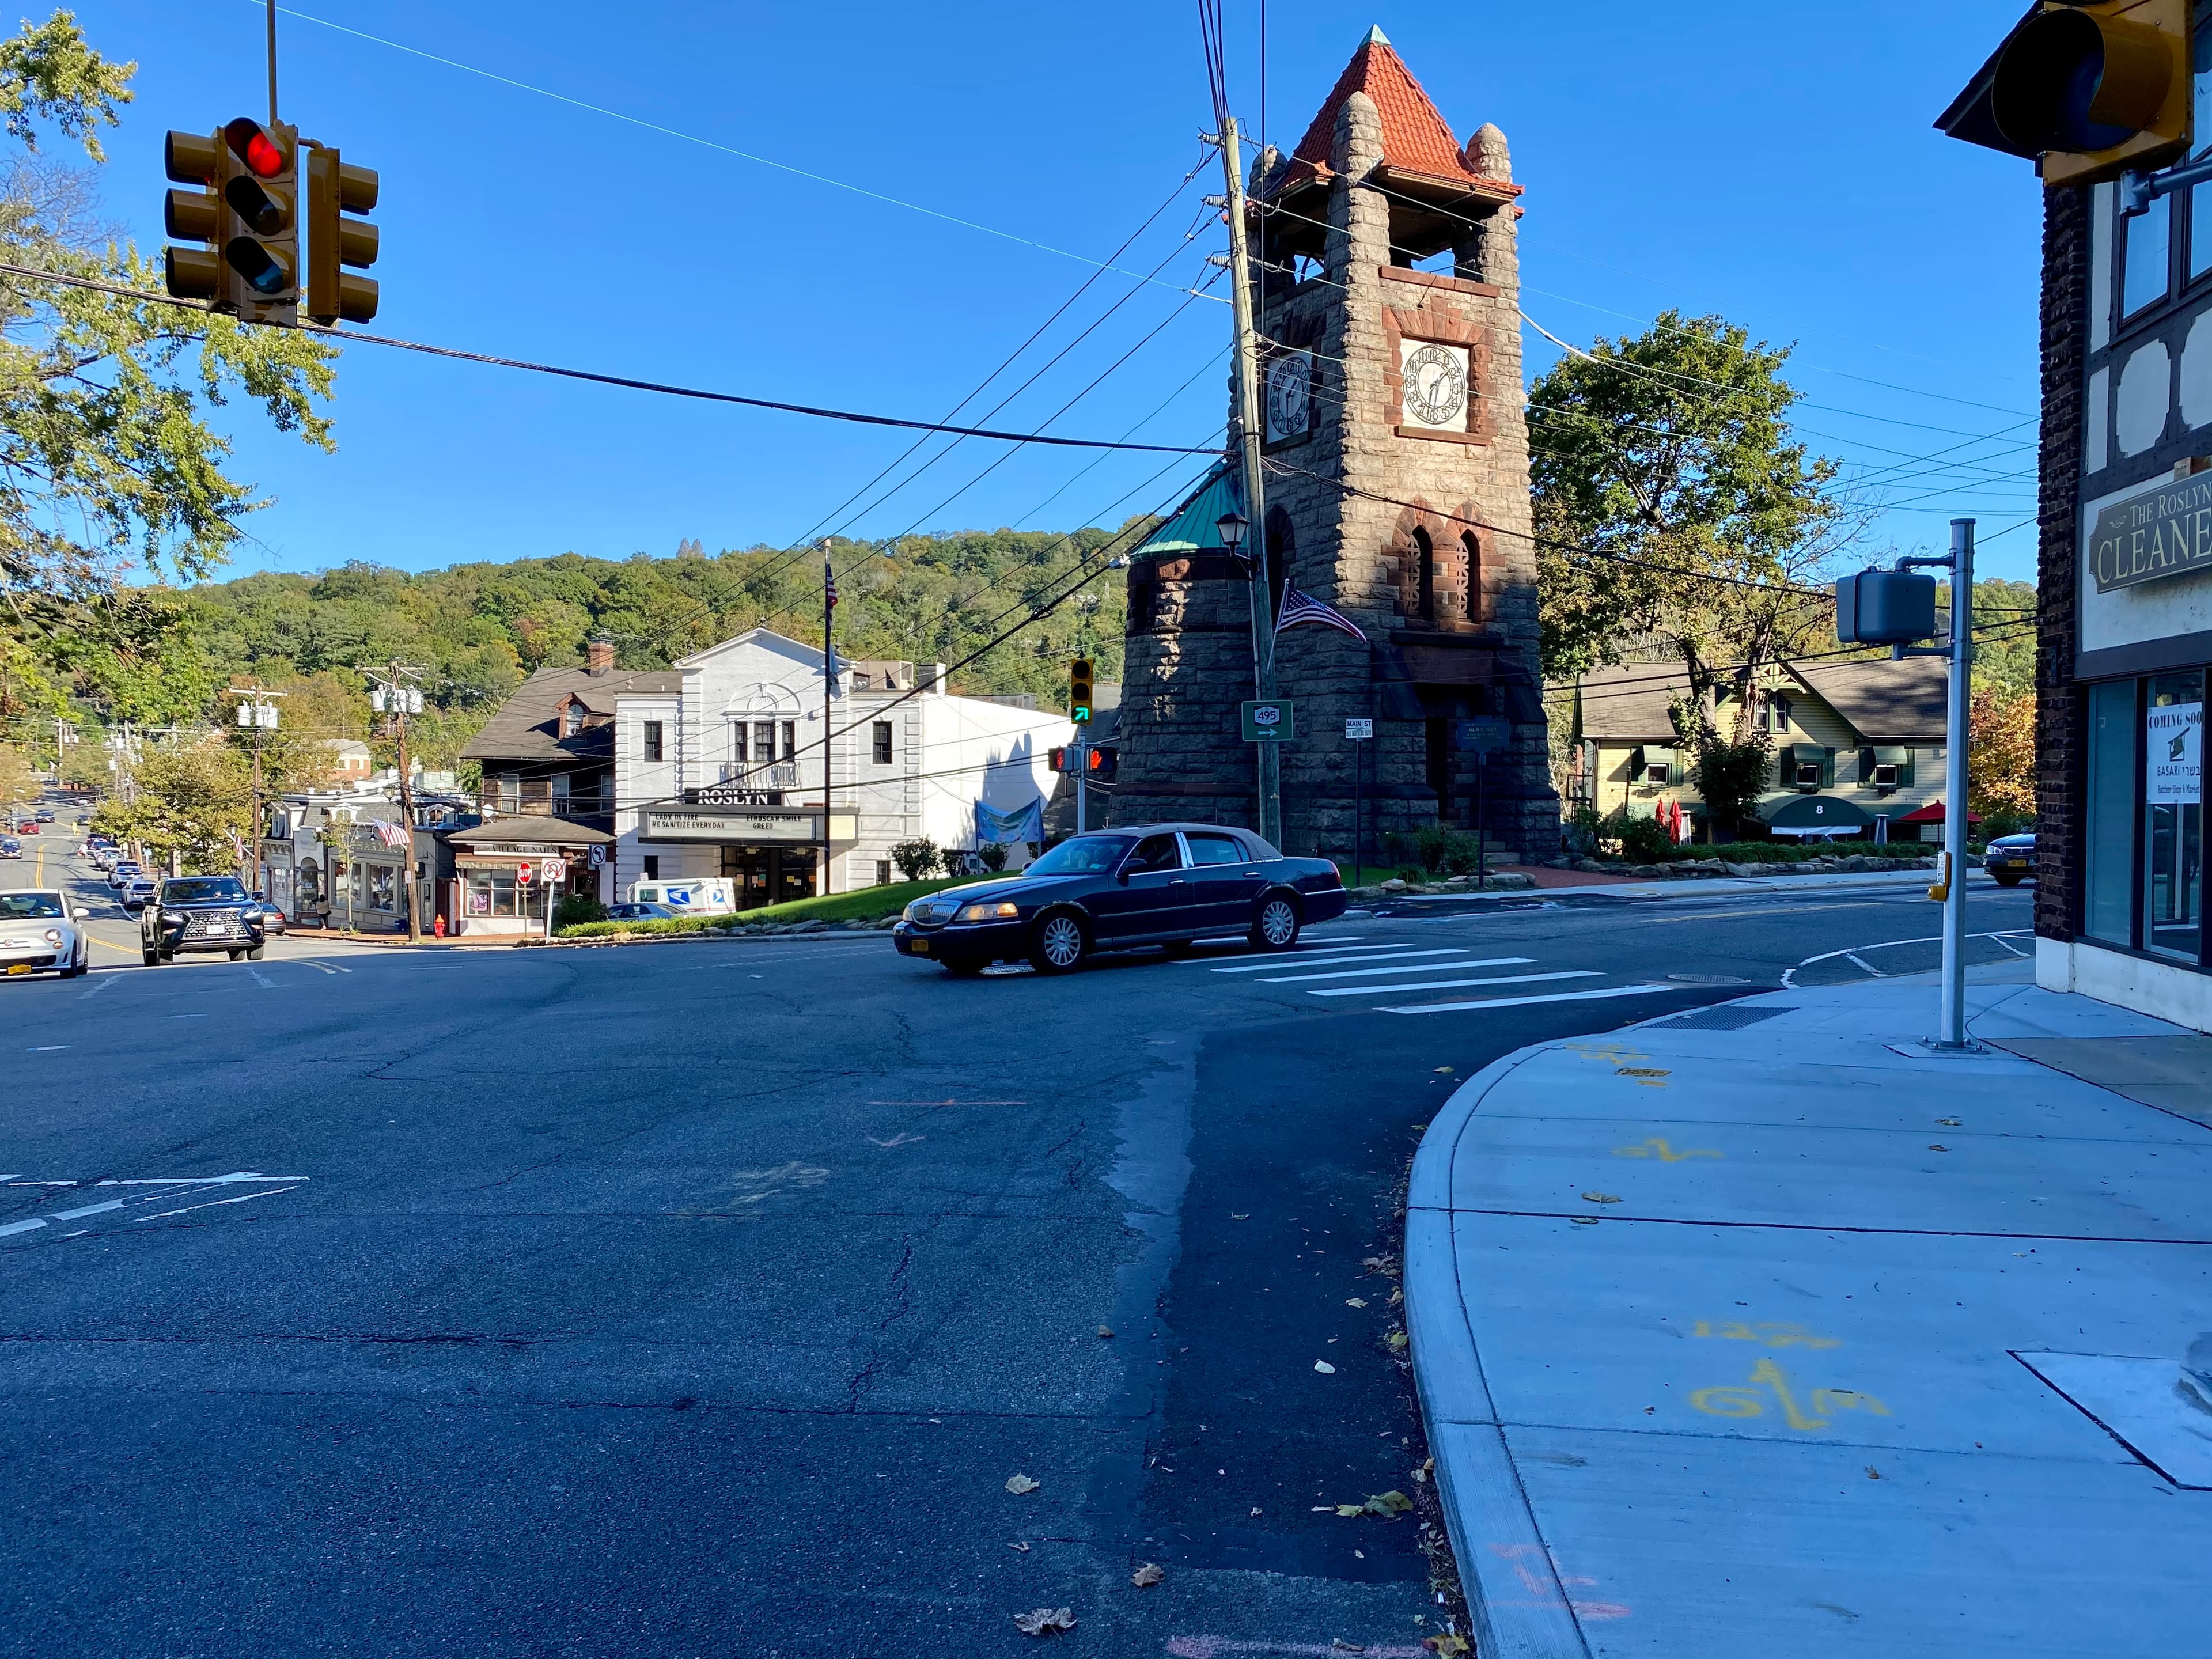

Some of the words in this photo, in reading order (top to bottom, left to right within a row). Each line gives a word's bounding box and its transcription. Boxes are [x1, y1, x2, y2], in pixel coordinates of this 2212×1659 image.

[2130, 502, 2153, 527] THE
[2158, 482, 2212, 518] ROSLYN
[1257, 711, 1277, 720] 495
[2149, 713, 2183, 729] COMING
[2157, 766, 2180, 776] BASARI
[2182, 766, 2200, 776] בשרי
[698, 790, 768, 805] ROSLYN
[1816, 805, 1823, 814] 8
[518, 869, 531, 877] STOP
